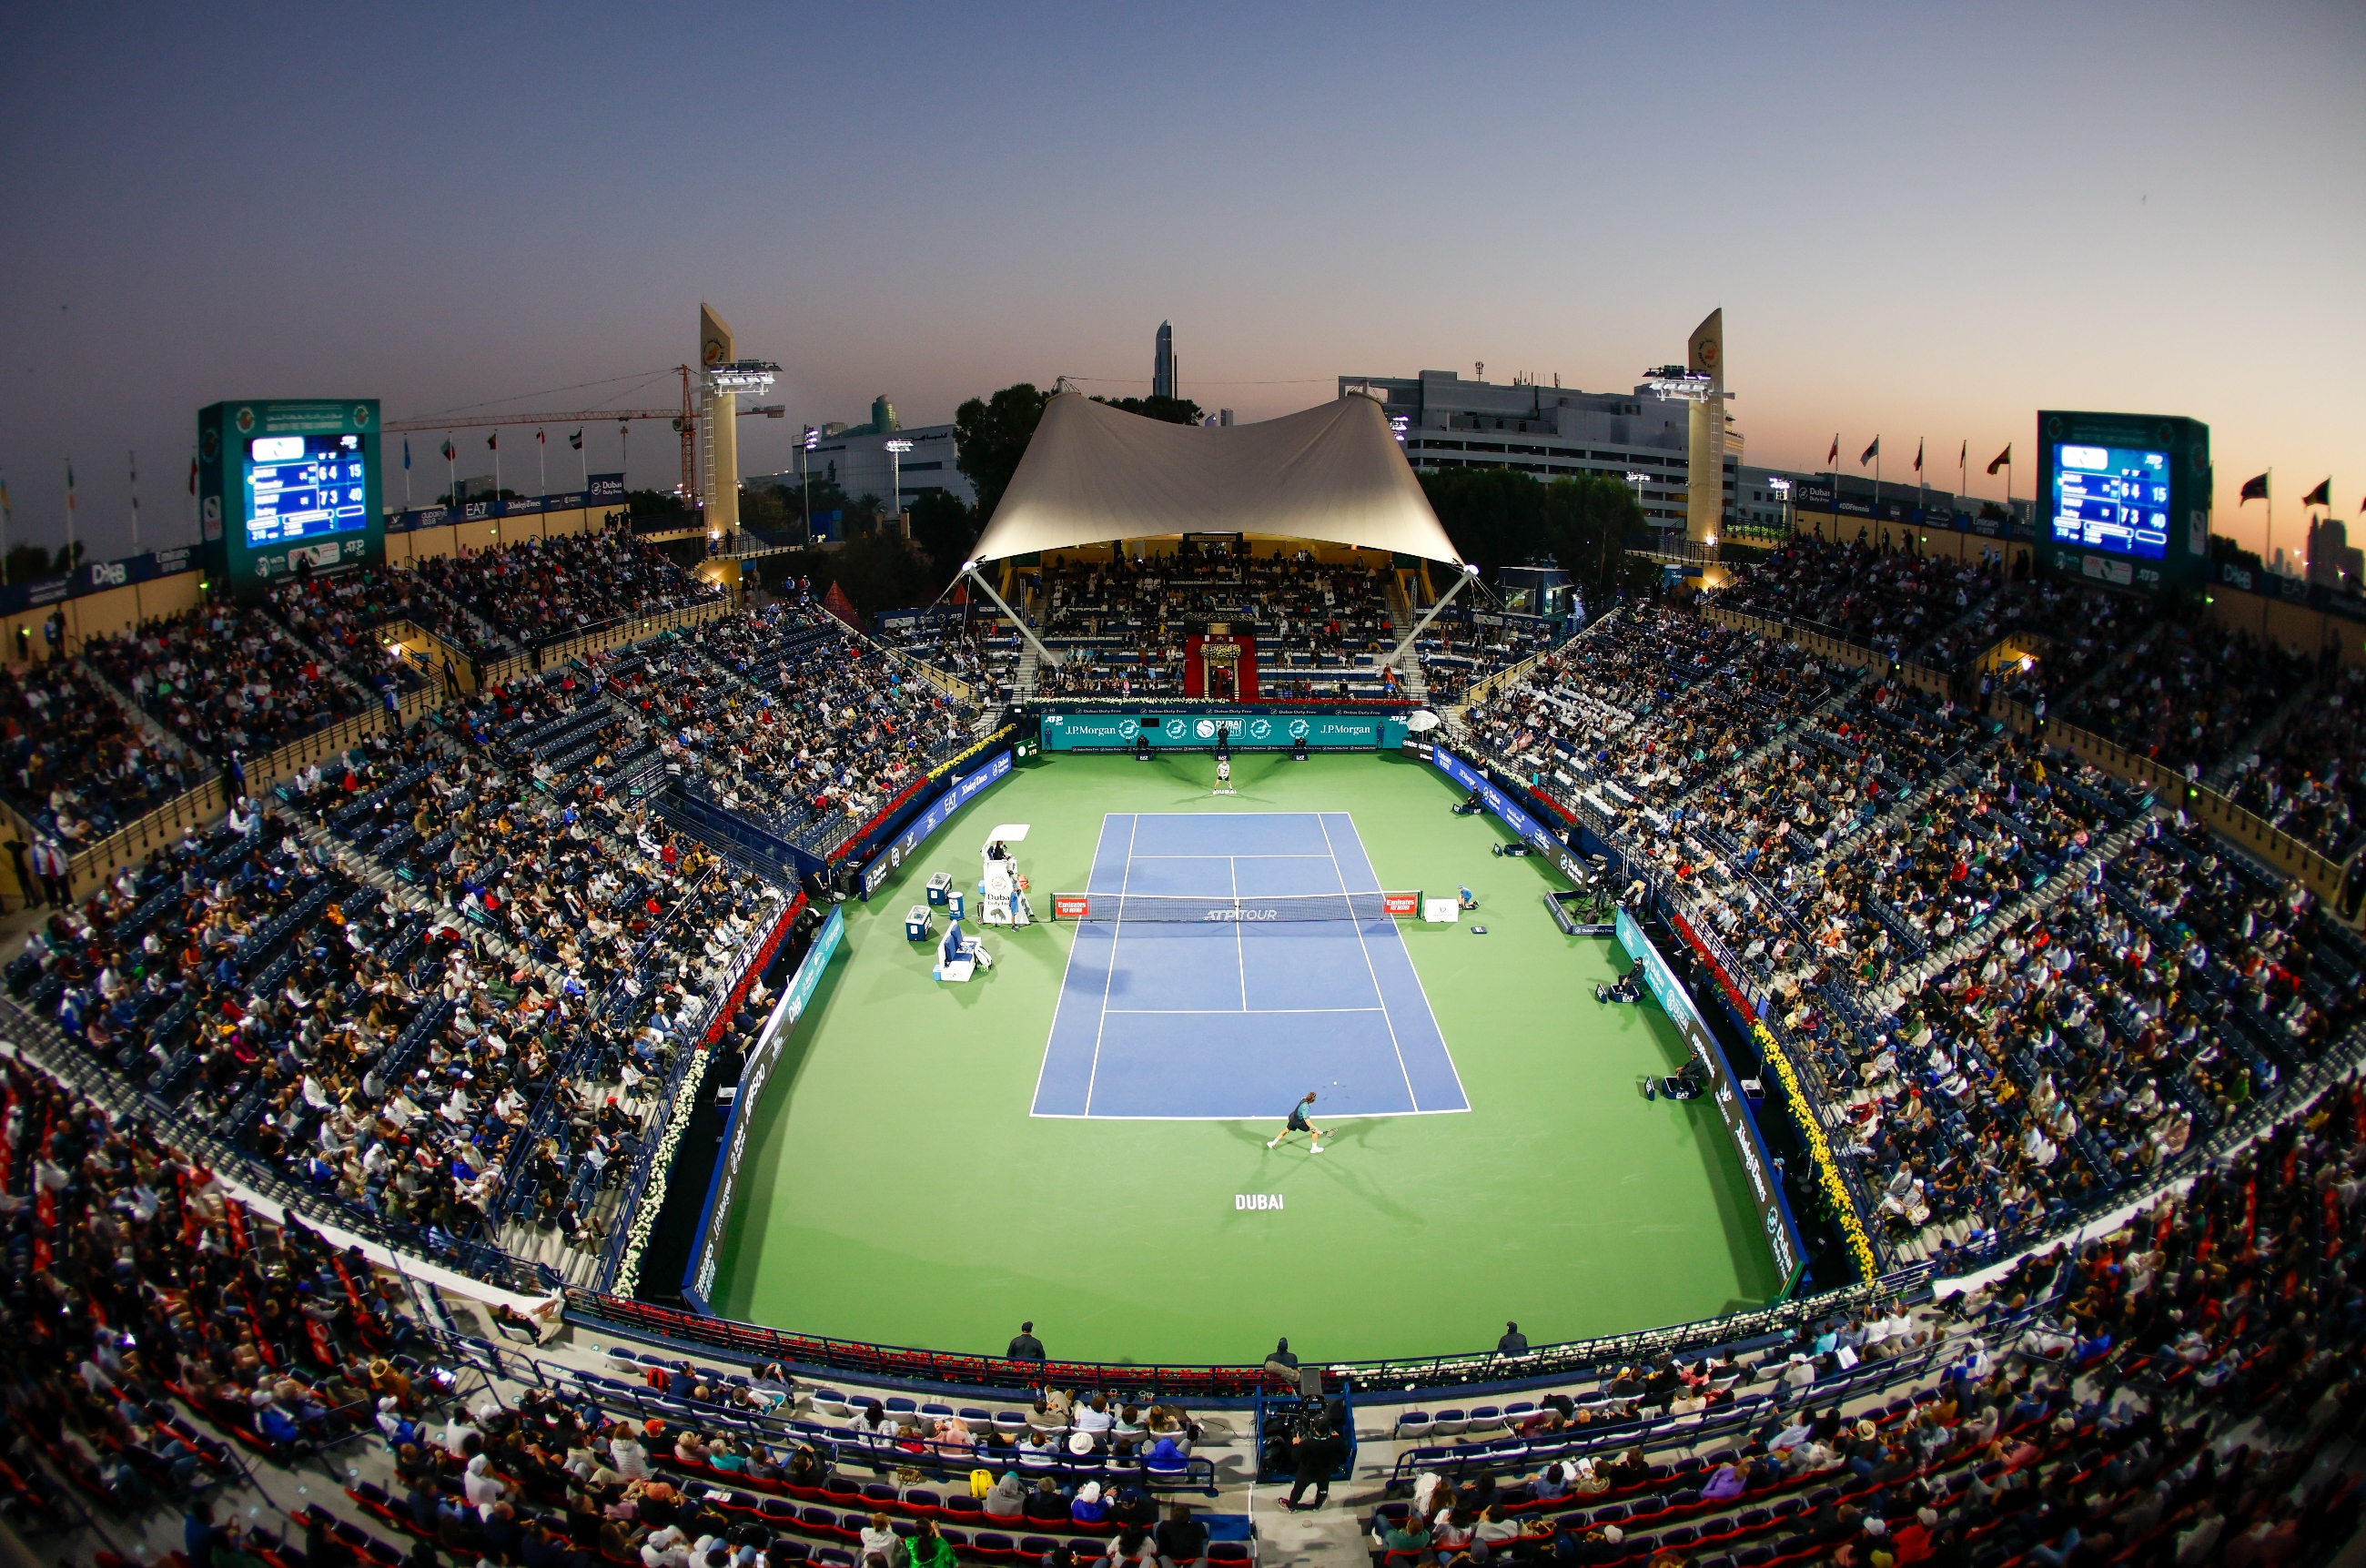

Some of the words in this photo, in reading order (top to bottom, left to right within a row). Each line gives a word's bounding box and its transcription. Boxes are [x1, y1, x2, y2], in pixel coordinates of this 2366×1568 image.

[319, 465, 327, 481] 6
[329, 466, 338, 480] 4
[349, 464, 361, 477] 15
[602, 481, 622, 489] Dubai
[1810, 487, 1830, 497] Dubai
[2121, 484, 2129, 497] 6
[2131, 485, 2139, 499] 4
[2153, 486, 2167, 501] 15
[320, 491, 328, 505] 7
[330, 490, 338, 504] 3
[349, 488, 362, 501] 40
[466, 502, 487, 516] EA7
[1839, 503, 1870, 513] #DDFtennis
[2121, 508, 2128, 522] 7
[2131, 510, 2138, 524] 3
[2151, 513, 2166, 529] 40
[344, 539, 364, 553] ATP
[1065, 726, 1116, 736] J.P.Morgan
[1320, 725, 1370, 735] J.P.Morgan
[944, 792, 956, 812] EA7
[873, 862, 887, 880] Dubai
[1569, 858, 1583, 878] Dubai
[1202, 910, 1236, 921] ATP
[1238, 909, 1277, 920] TOUR
[1651, 961, 1665, 988] Dubai
[1673, 1004, 1689, 1031] DUBAI
[713, 1176, 732, 1240] J.P.Morgan
[1235, 1194, 1284, 1210] DUBAI
[1777, 1223, 1793, 1272] Dubai
